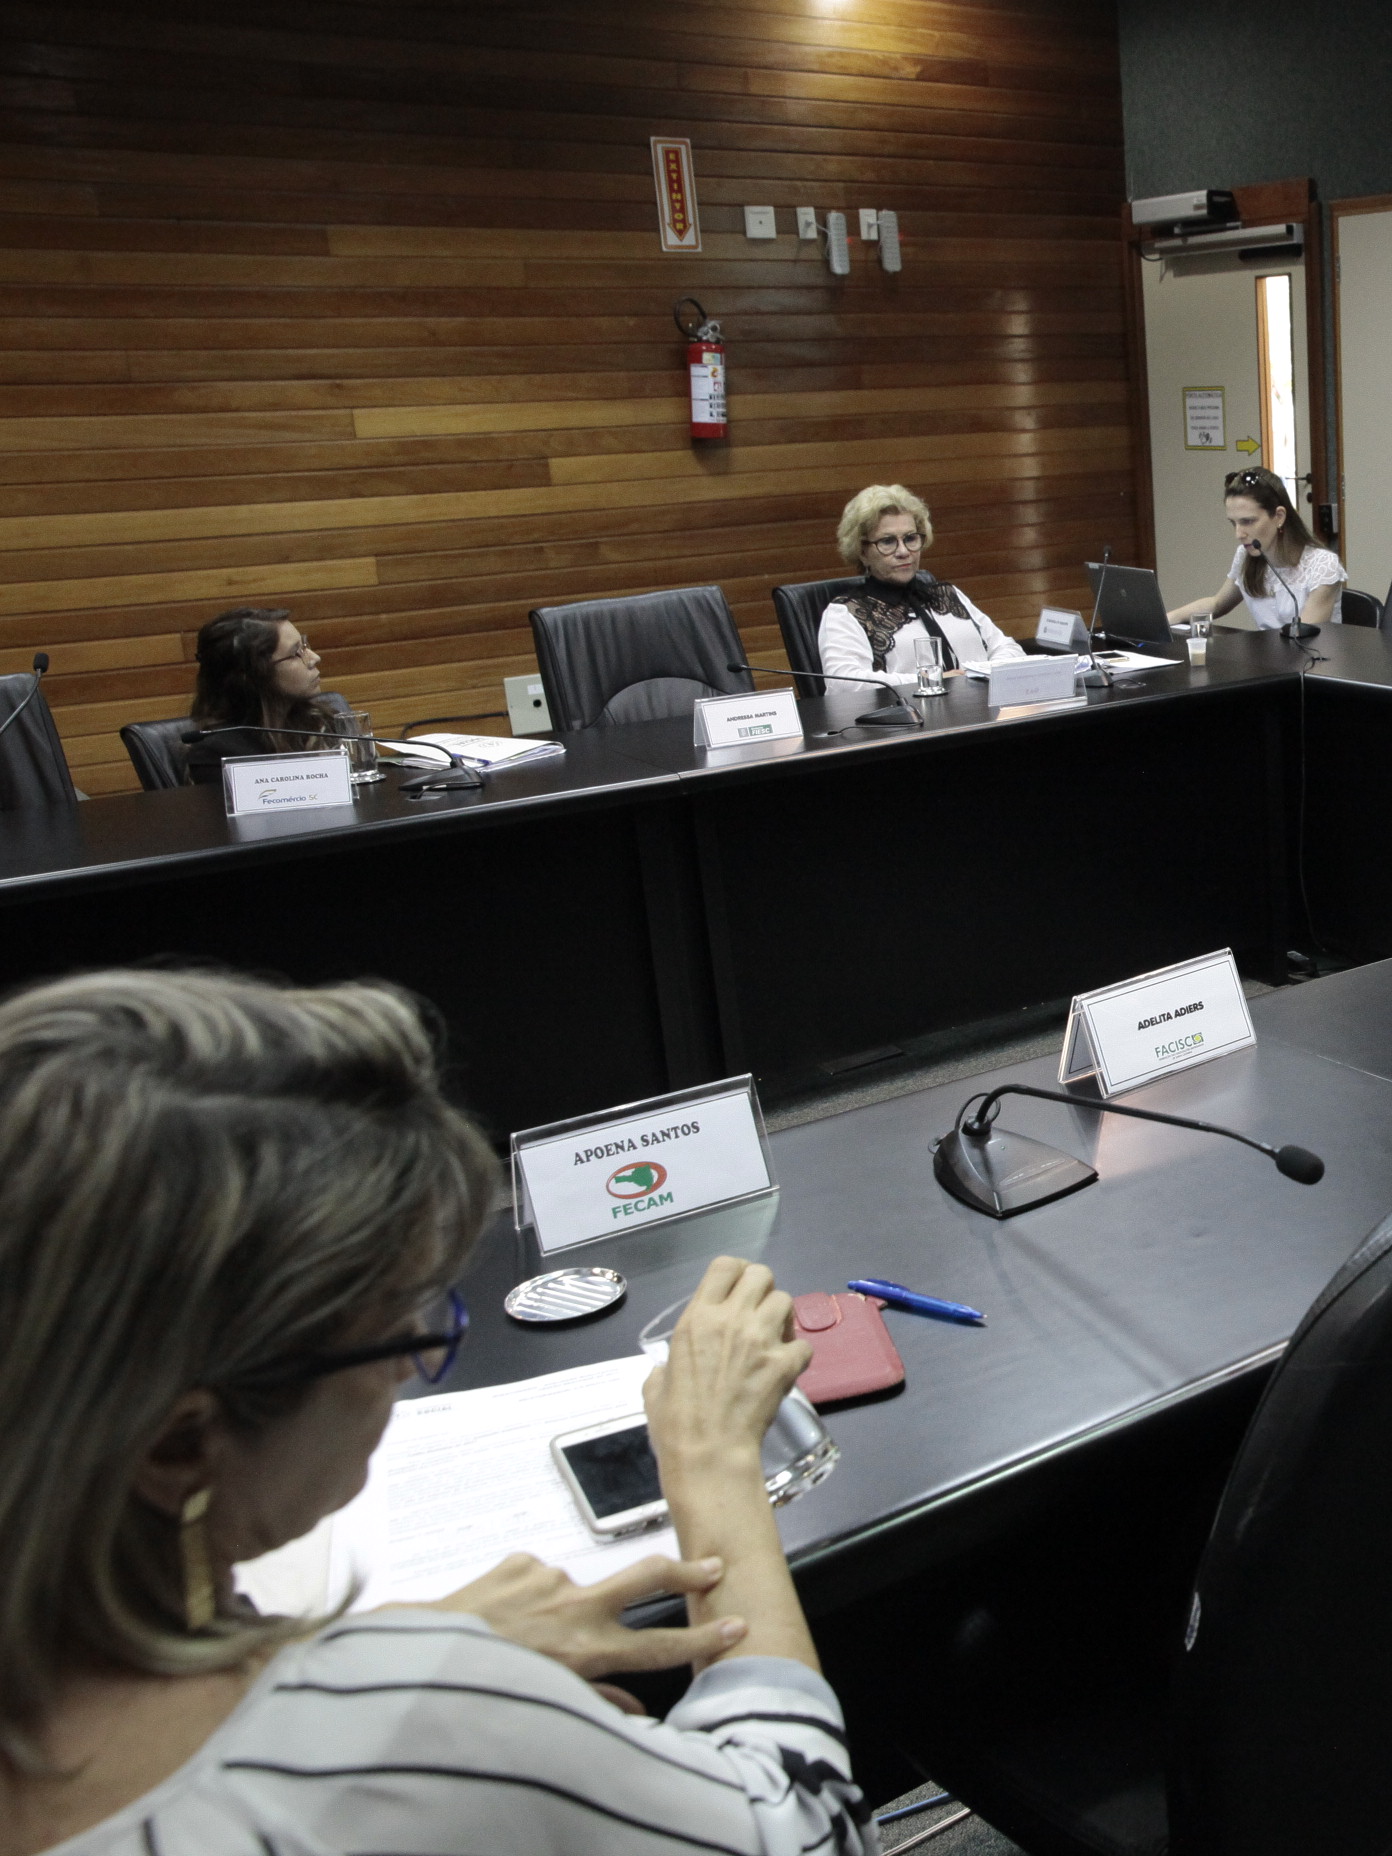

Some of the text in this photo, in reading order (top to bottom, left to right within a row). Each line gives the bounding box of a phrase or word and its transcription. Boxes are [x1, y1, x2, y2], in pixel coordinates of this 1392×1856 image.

[270, 775, 304, 784] CAROLINA
[306, 773, 329, 781] ROCHA
[262, 795, 306, 805] Fecomércio
[1137, 1001, 1204, 1031] ADELITA ADIERS
[1154, 1034, 1192, 1058] FACISC
[573, 1121, 700, 1165] APOENA SANTOS
[611, 1191, 674, 1219] FECAM
